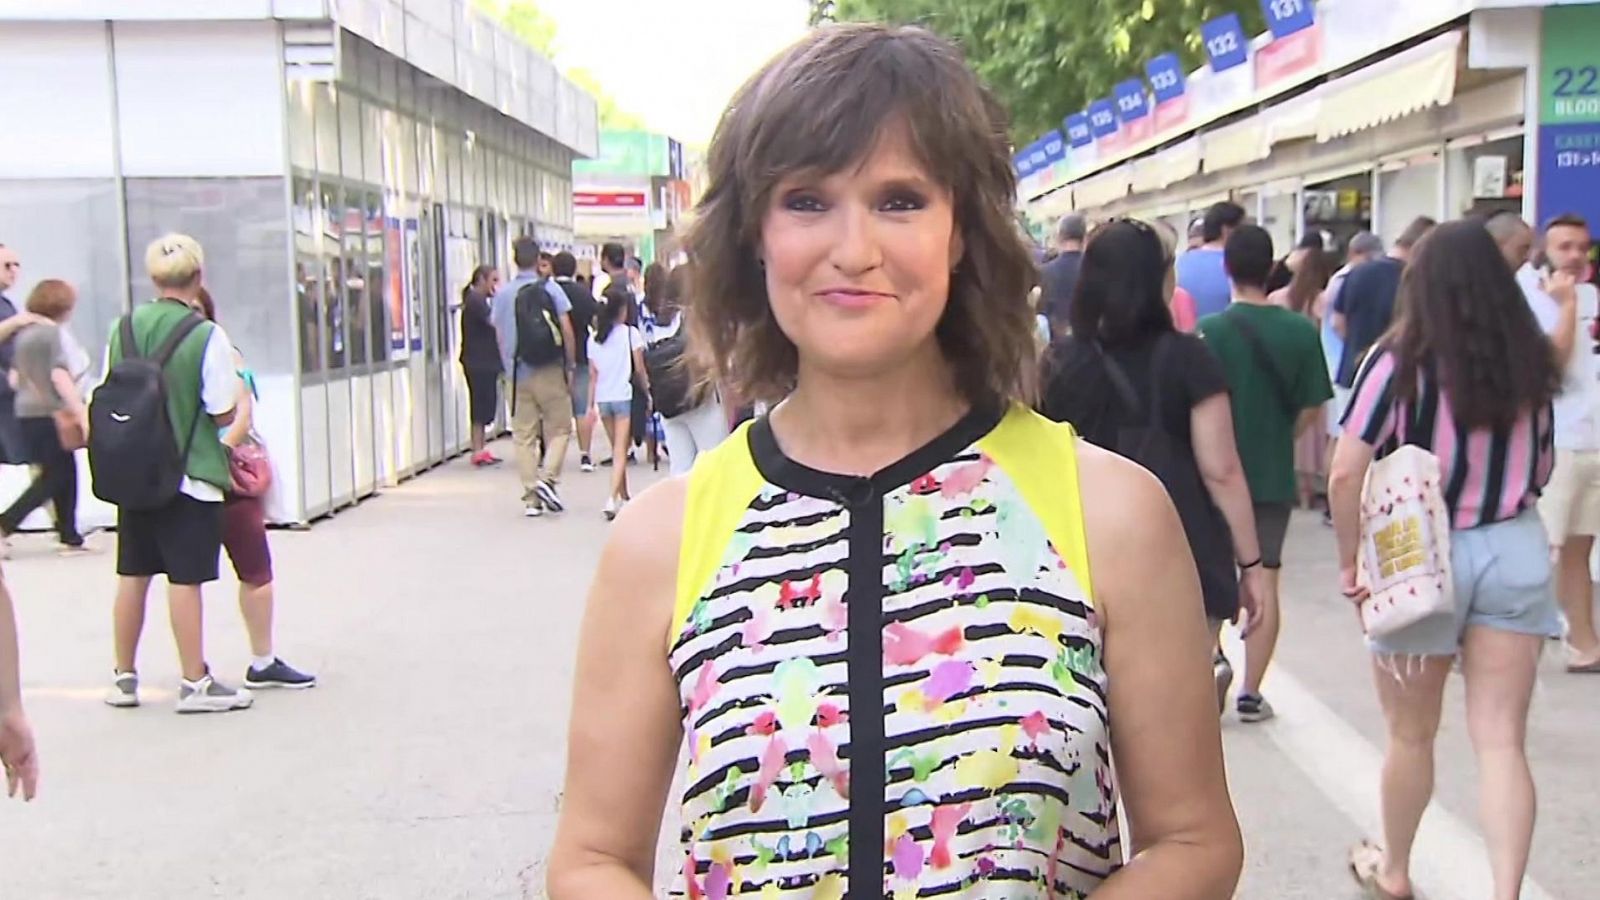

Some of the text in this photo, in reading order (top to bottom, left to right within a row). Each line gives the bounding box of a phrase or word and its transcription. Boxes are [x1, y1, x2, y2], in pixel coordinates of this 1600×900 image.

[1207, 31, 1238, 56] 132
[1150, 69, 1177, 90] 133
[1553, 66, 1598, 97] 22
[1118, 92, 1143, 112] 134
